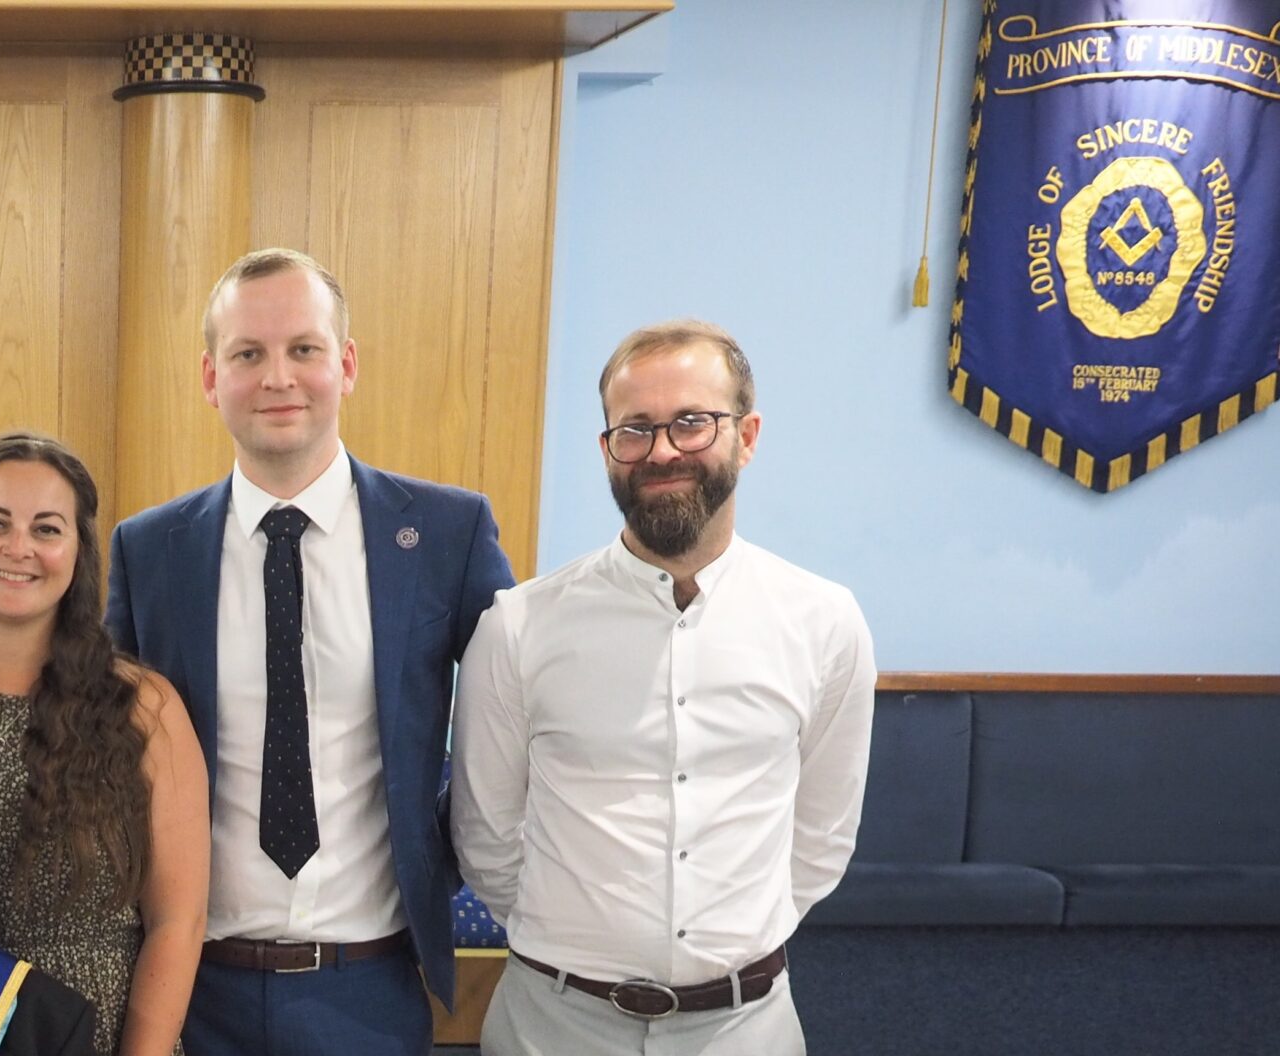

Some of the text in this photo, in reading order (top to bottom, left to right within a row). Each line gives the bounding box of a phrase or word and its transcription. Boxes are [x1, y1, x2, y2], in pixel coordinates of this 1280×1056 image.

[1007, 36, 1112, 79] PROVINCE
[1125, 35, 1153, 62] OF
[1027, 118, 1236, 313] LODGE OF SINCERE FRIENDSHIP
[1072, 364, 1161, 379] CONSECRATED
[1098, 378, 1159, 392] FEBRUARY
[1100, 390, 1131, 403] 1974
